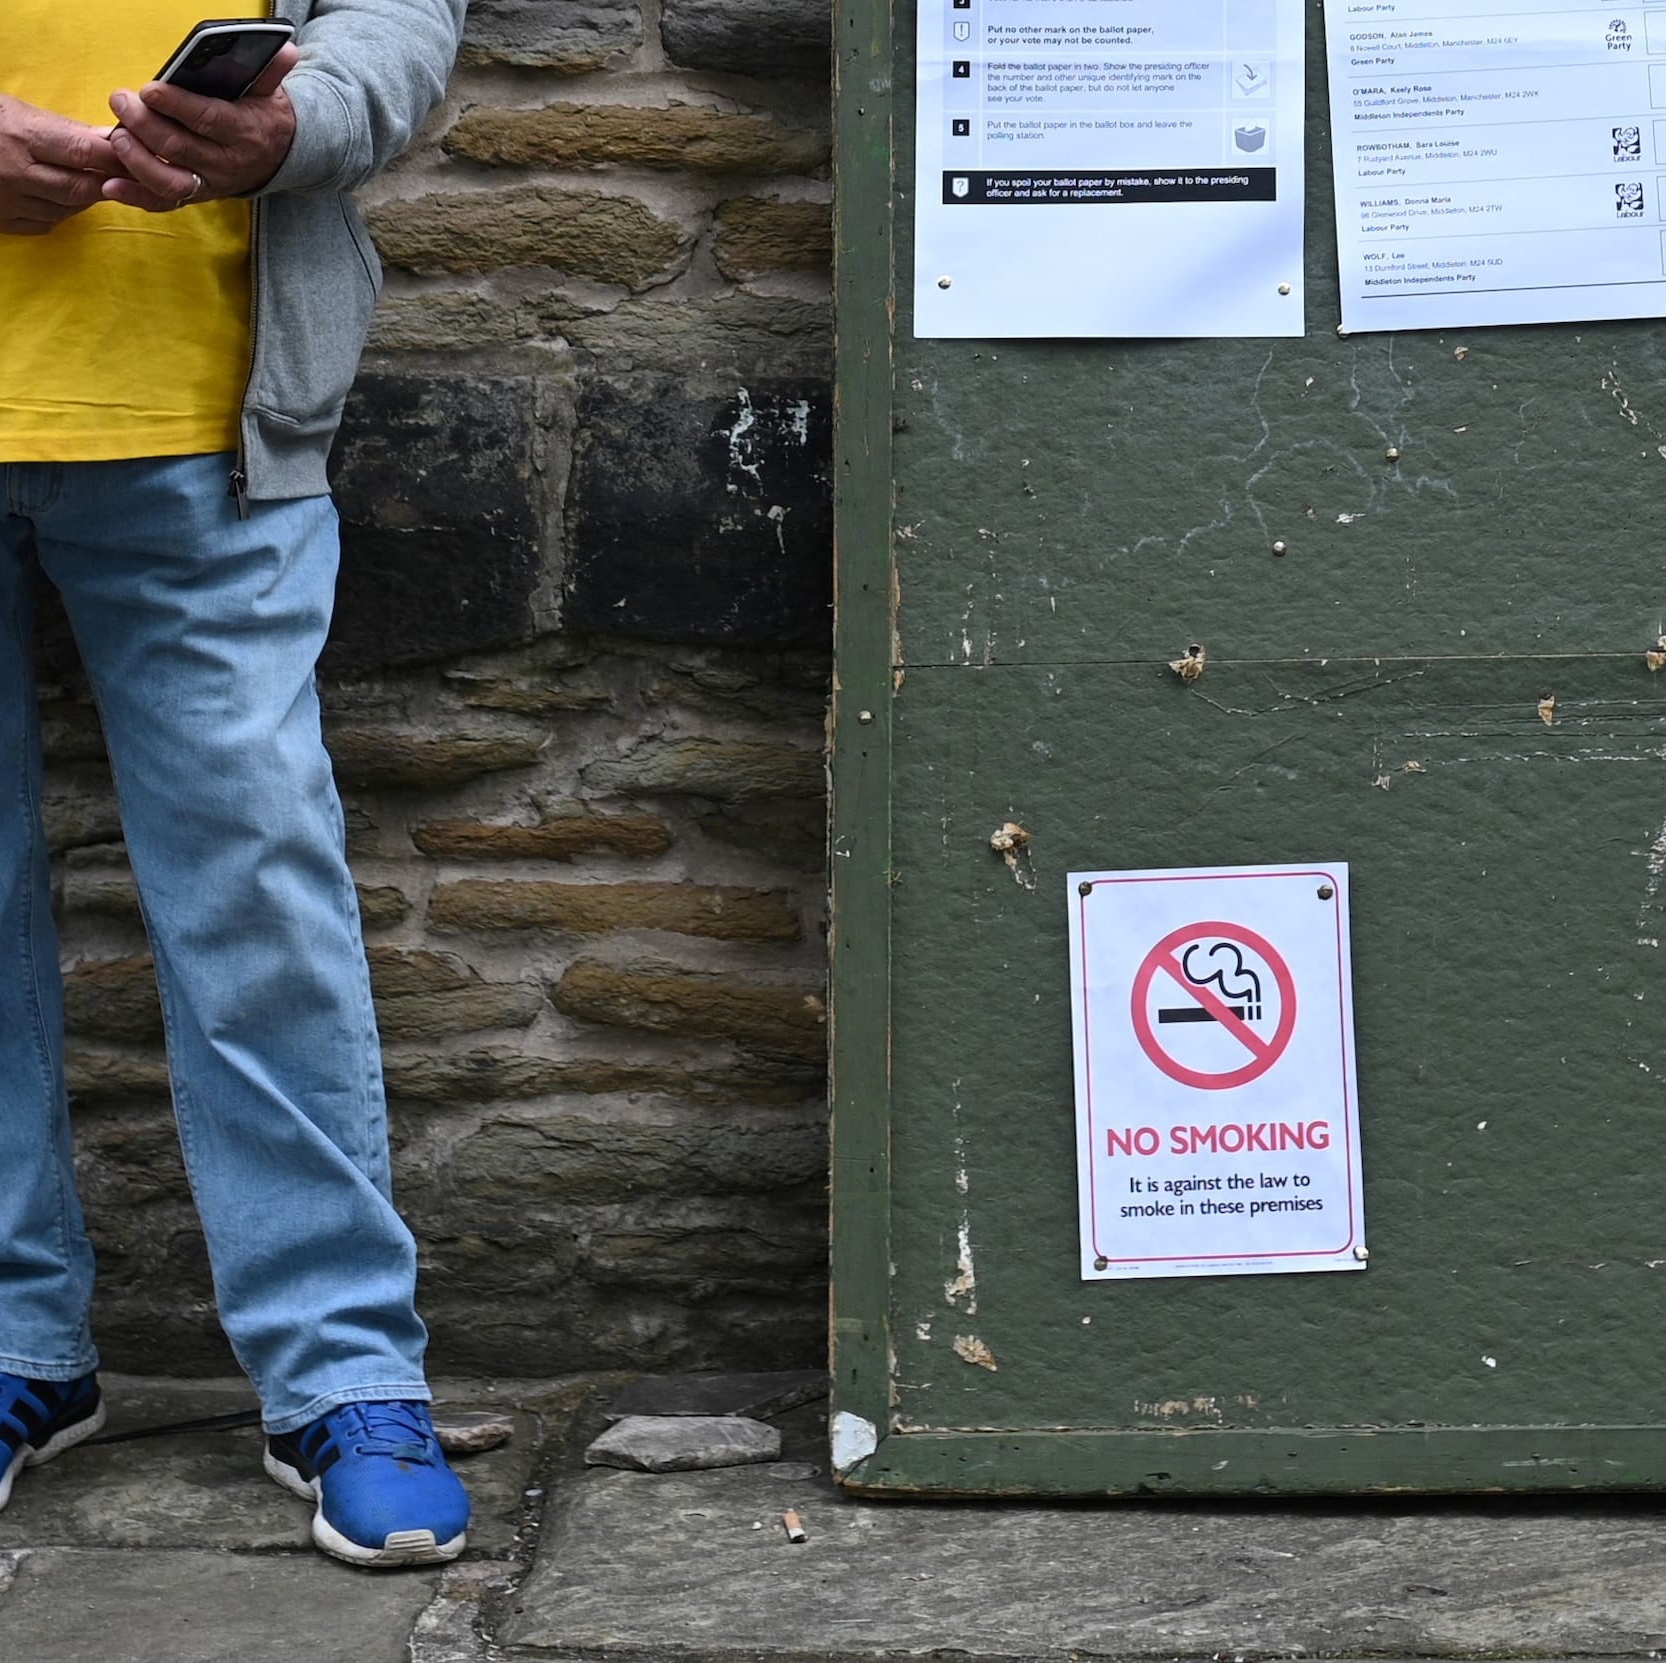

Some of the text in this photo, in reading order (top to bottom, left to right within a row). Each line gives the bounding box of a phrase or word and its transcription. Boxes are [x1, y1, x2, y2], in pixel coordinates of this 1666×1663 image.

[987, 25, 1002, 33] Put
[1126, 27, 1154, 35] paper,
[999, 37, 1019, 45] your
[1021, 36, 1041, 44] vote
[1043, 37, 1062, 46] may
[1081, 36, 1092, 44] be
[1094, 36, 1133, 44] counted.
[1605, 34, 1632, 43] Green
[1607, 42, 1631, 51] Party
[1107, 1120, 1329, 1156] NO SMOKING
[1130, 1172, 1310, 1196] It is against the law to
[1120, 1195, 1323, 1217] smoke in these premises
